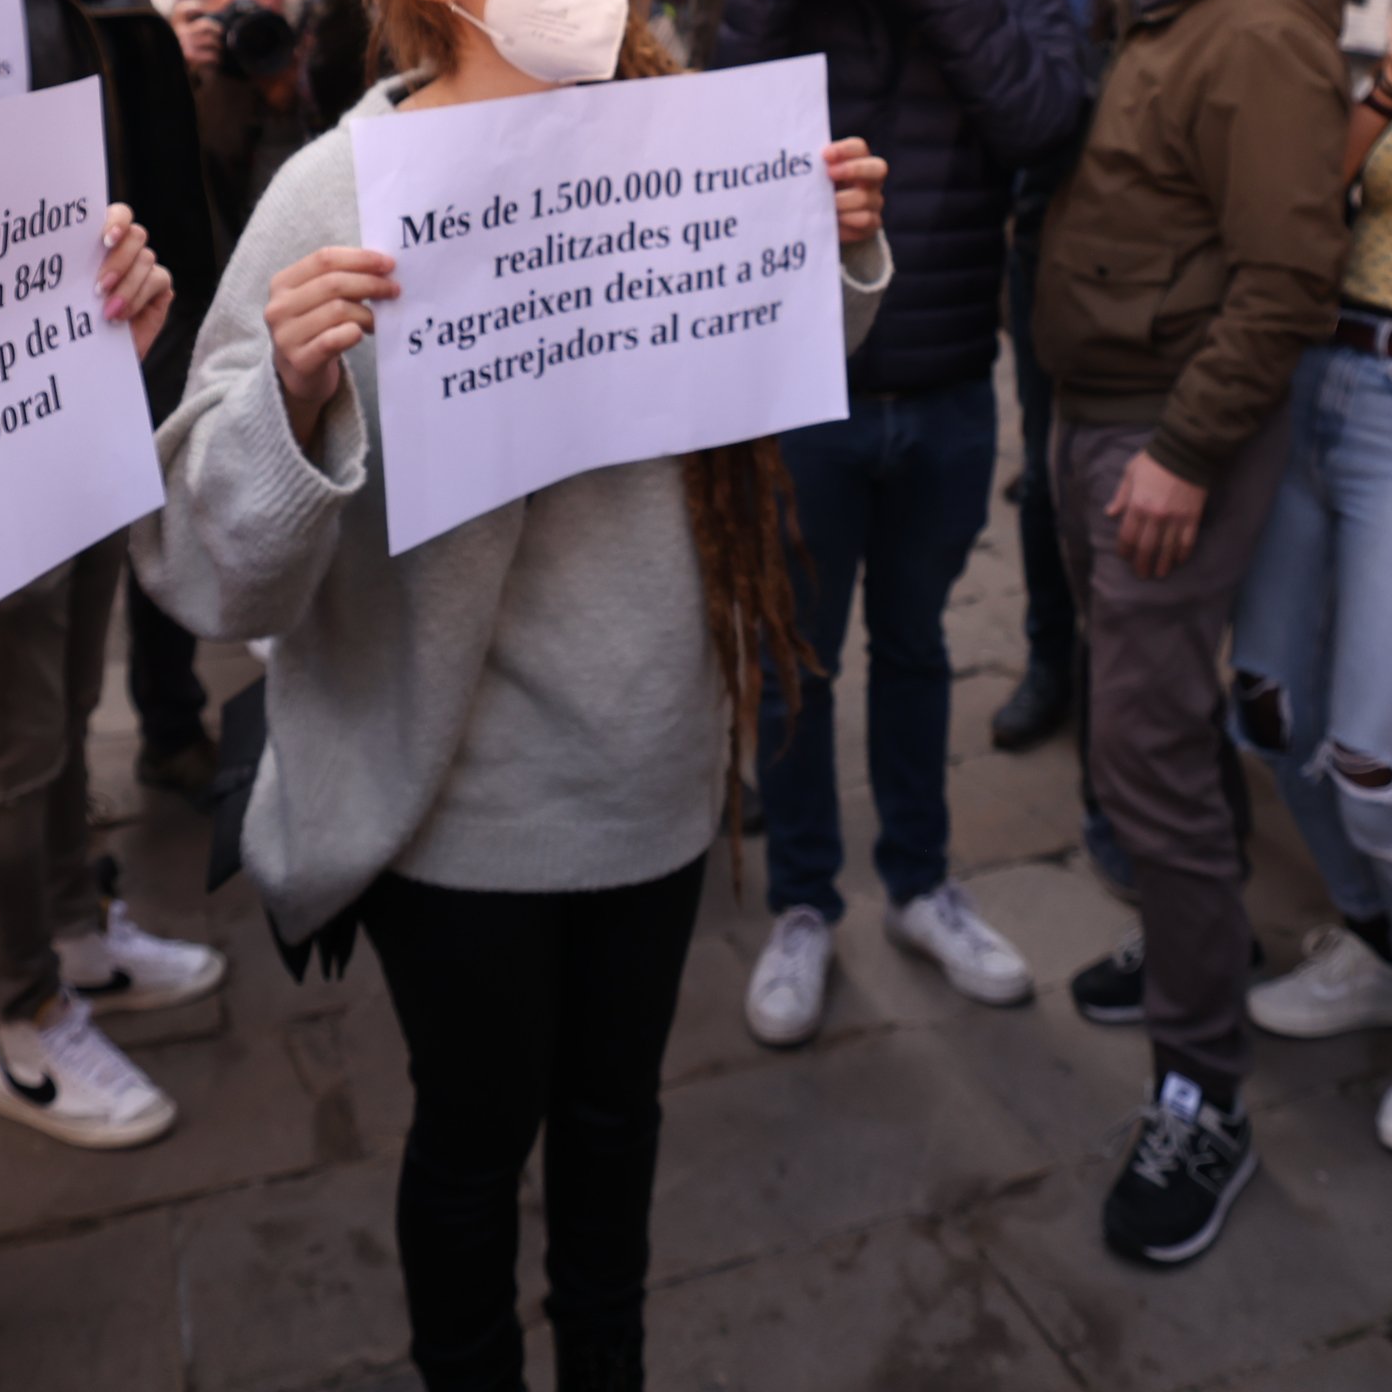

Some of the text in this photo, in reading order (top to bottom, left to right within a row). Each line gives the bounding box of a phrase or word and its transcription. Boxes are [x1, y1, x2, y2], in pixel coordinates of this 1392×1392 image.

[398, 149, 814, 250] Més de 1.500.000 trucades
[13, 251, 65, 305] 849
[493, 214, 739, 279] realitzades que
[24, 313, 60, 360] de
[64, 300, 94, 348] la
[407, 240, 808, 356] s’agraeixen deixant a 849
[440, 295, 785, 400] rastrejadors al carrer
